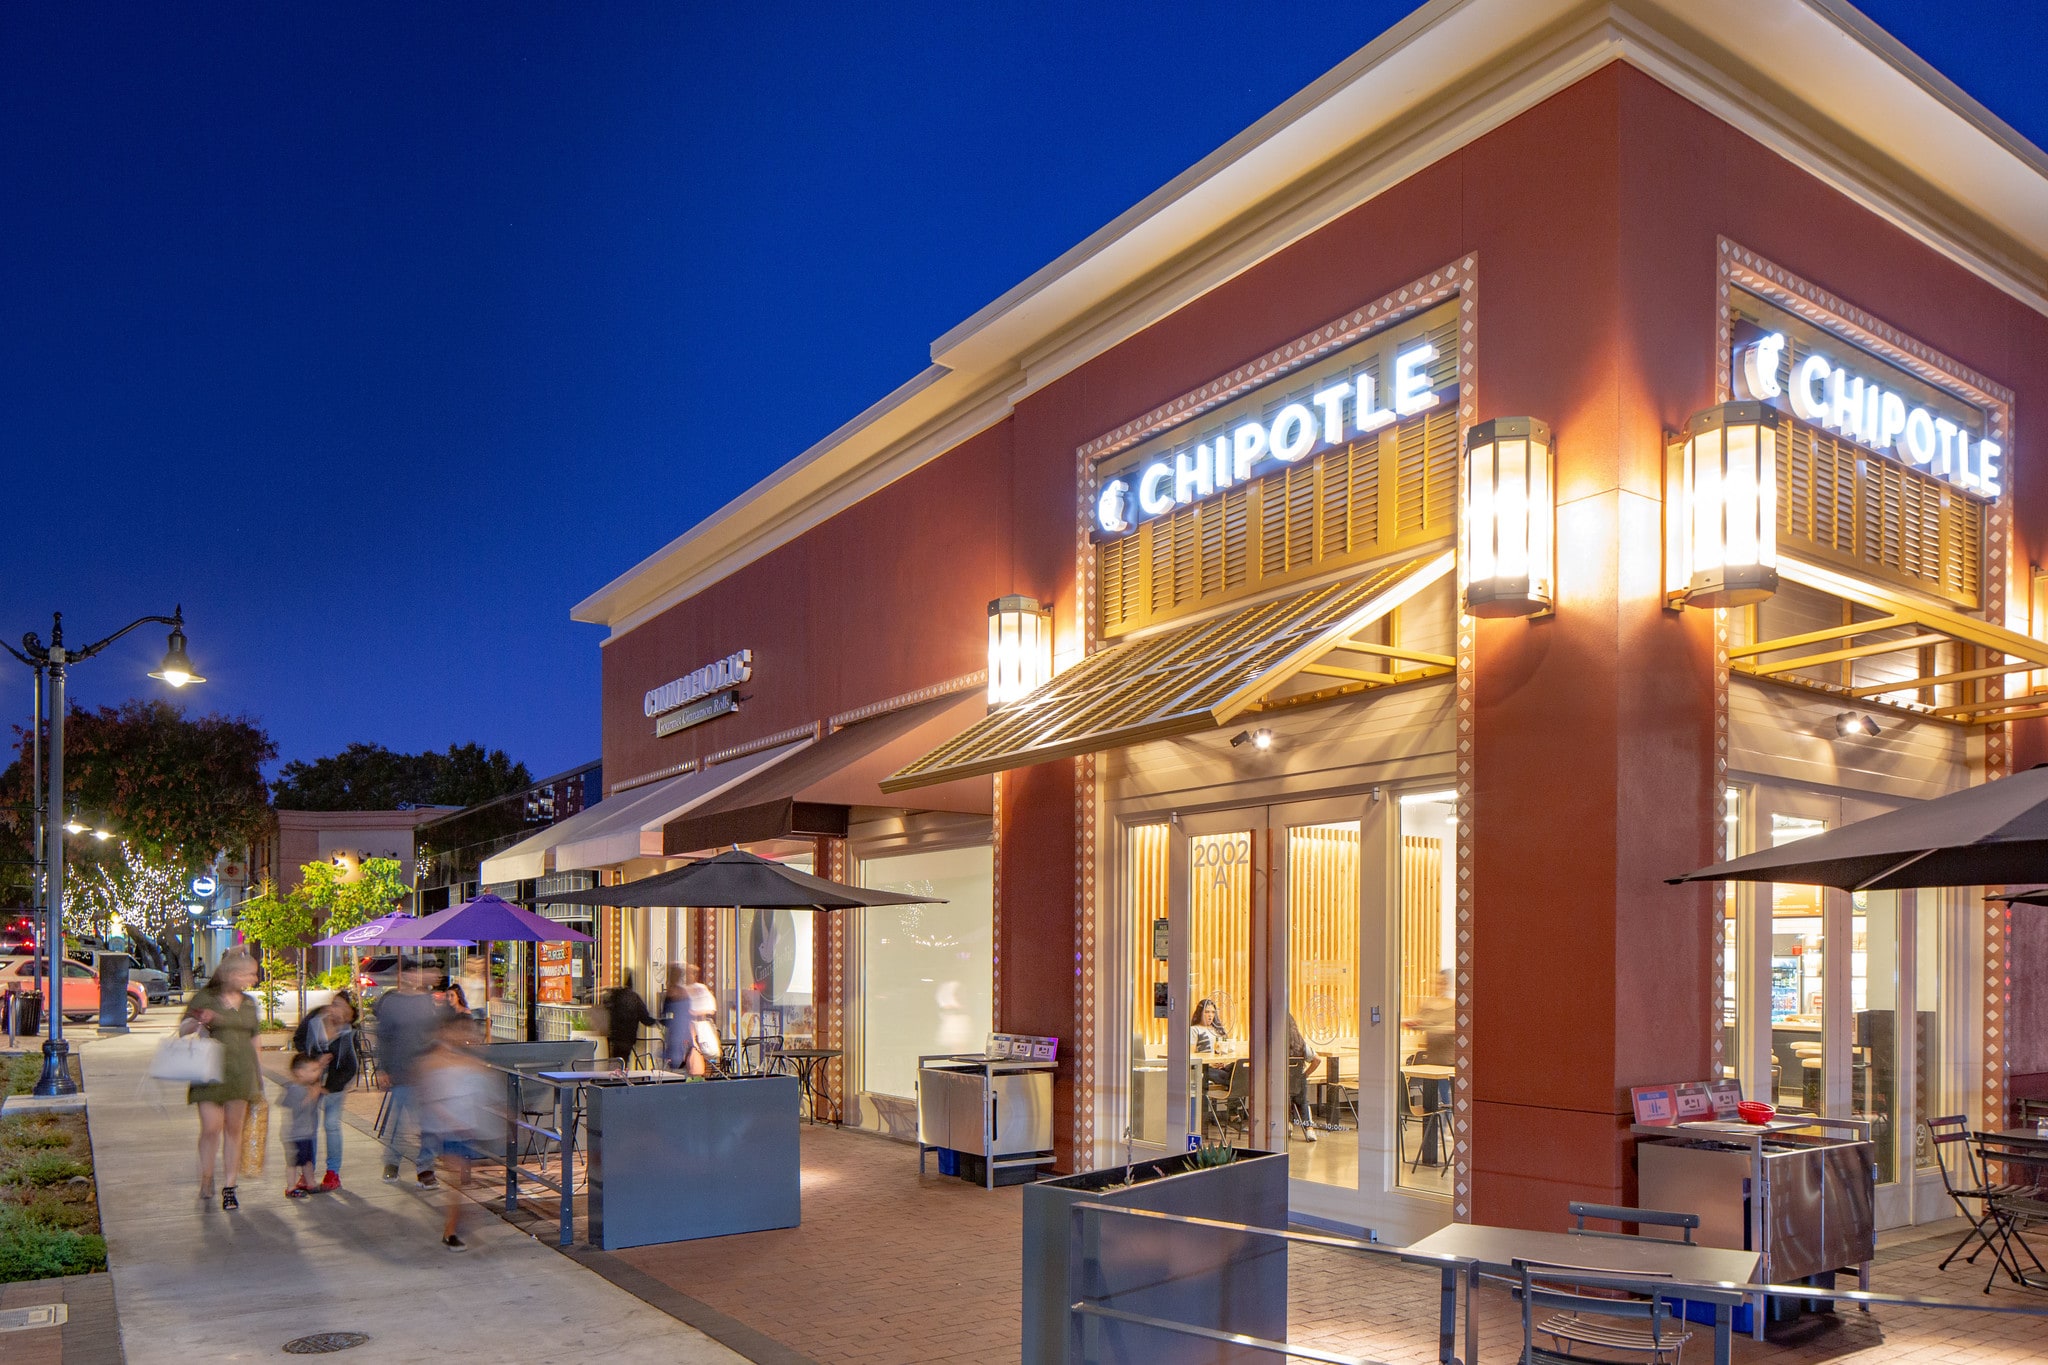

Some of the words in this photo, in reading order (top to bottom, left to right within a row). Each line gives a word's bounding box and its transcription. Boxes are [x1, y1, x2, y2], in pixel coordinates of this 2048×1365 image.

[1139, 344, 1441, 515] CHIPOTLE
[1793, 355, 2002, 497] CHIPOTLE
[644, 649, 752, 717] CINNAHOLIC
[682, 706, 713, 723] Cinnamon
[713, 696, 730, 713] Rolls
[1194, 840, 1249, 867] 2002
[1213, 866, 1228, 889] A
